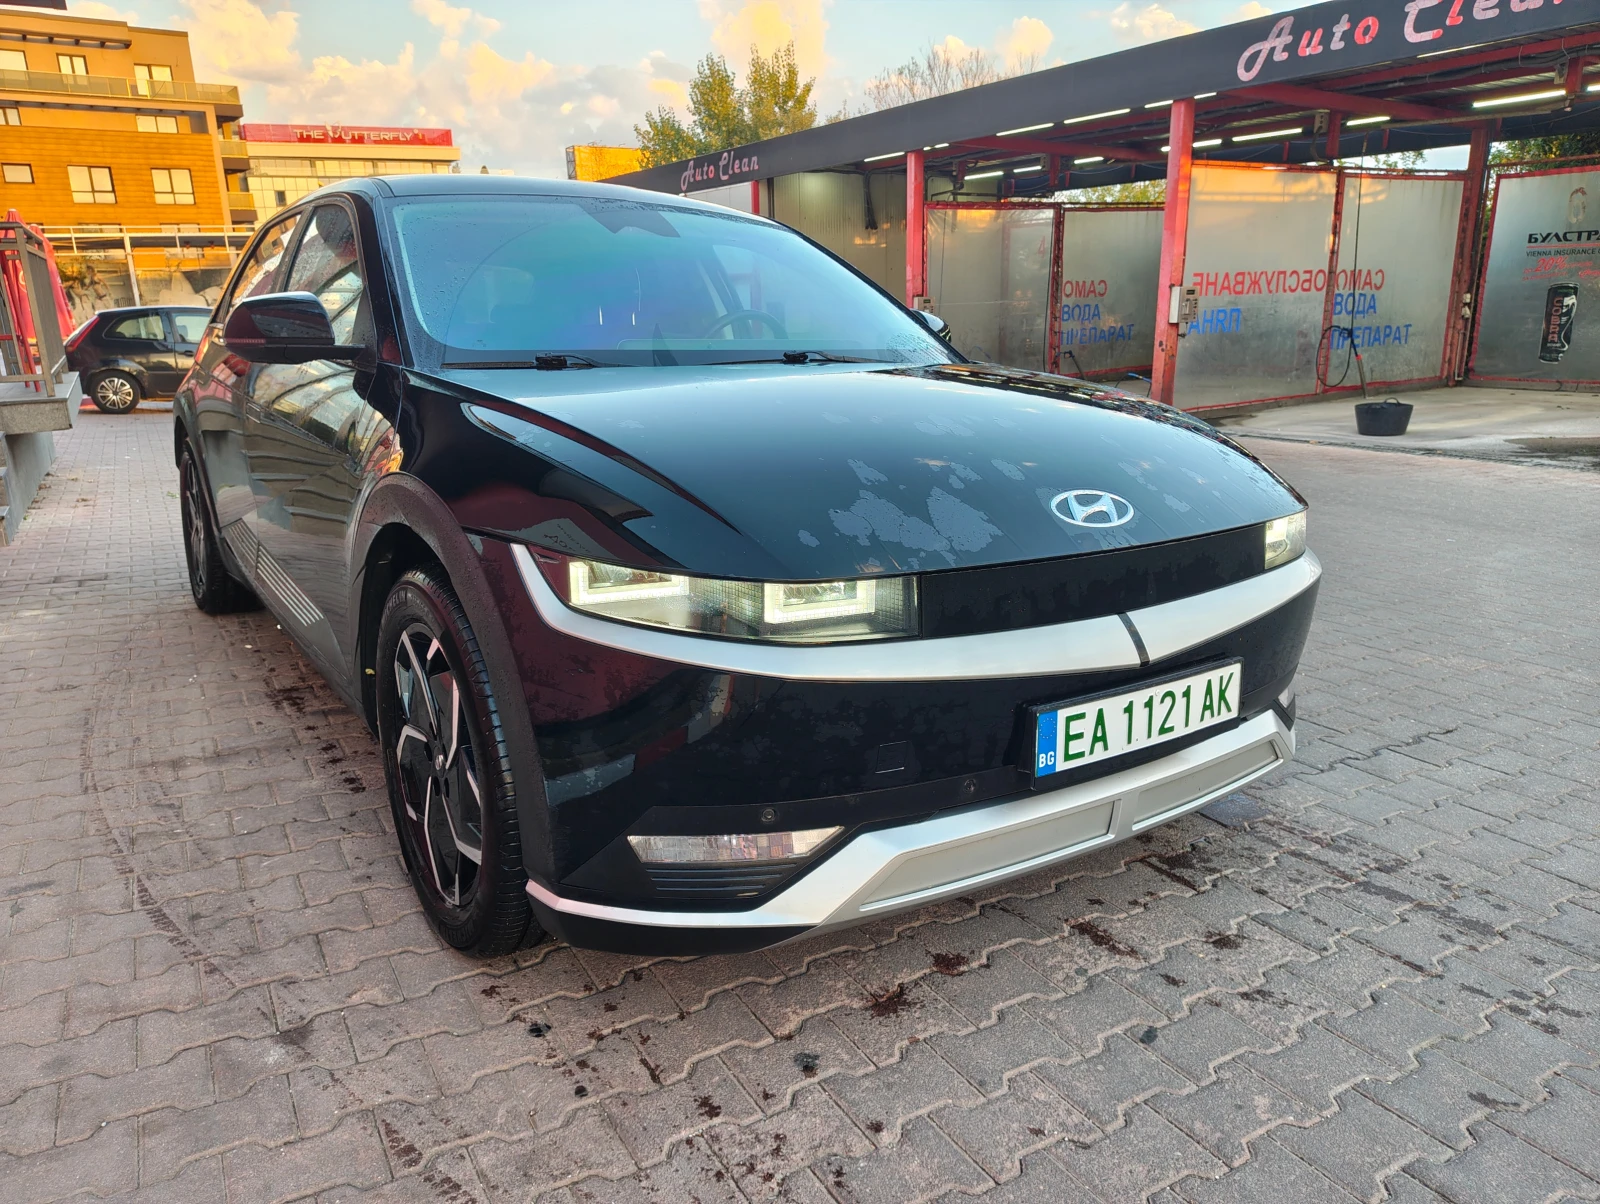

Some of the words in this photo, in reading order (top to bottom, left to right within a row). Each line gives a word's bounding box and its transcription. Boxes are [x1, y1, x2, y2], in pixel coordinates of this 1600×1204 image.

[1236, 14, 1379, 82] Auto
[1403, 0, 1564, 44] Cle
[293, 129, 325, 139] THE
[680, 160, 715, 191] Auto
[718, 151, 759, 180] Clean
[1526, 249, 1552, 258] VIENNA
[1553, 248, 1596, 256] INSURANCE
[1534, 256, 1568, 273] 20%
[1062, 304, 1101, 324] ВОДА
[1333, 292, 1377, 319] ВОДА
[1063, 707, 1109, 762] EA
[1123, 684, 1192, 745] 1121
[1199, 671, 1235, 722] AK
[1038, 751, 1055, 768] BG
